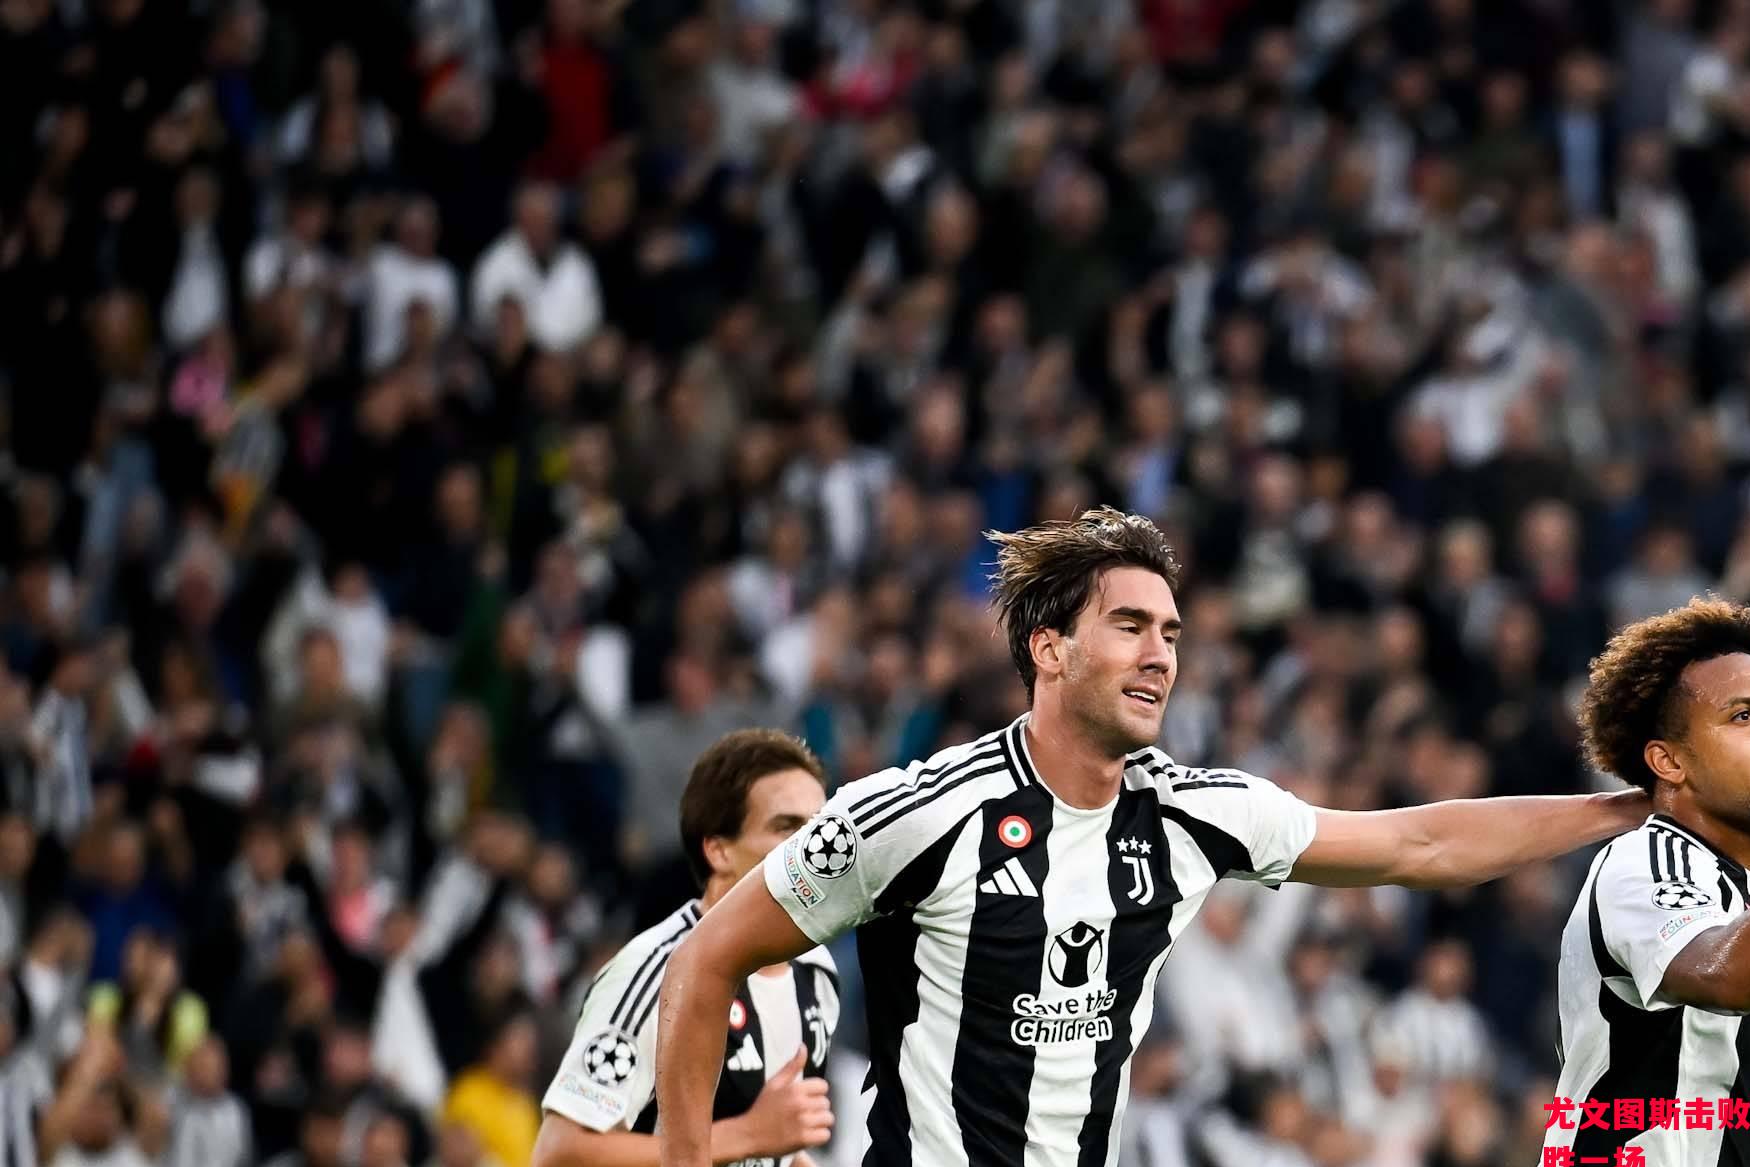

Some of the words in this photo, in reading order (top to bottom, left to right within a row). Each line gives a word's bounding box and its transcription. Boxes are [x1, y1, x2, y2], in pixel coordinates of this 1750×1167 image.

[1017, 997, 1079, 1015] Save
[1086, 989, 1115, 1013] the
[1014, 1019, 1110, 1043] Children
